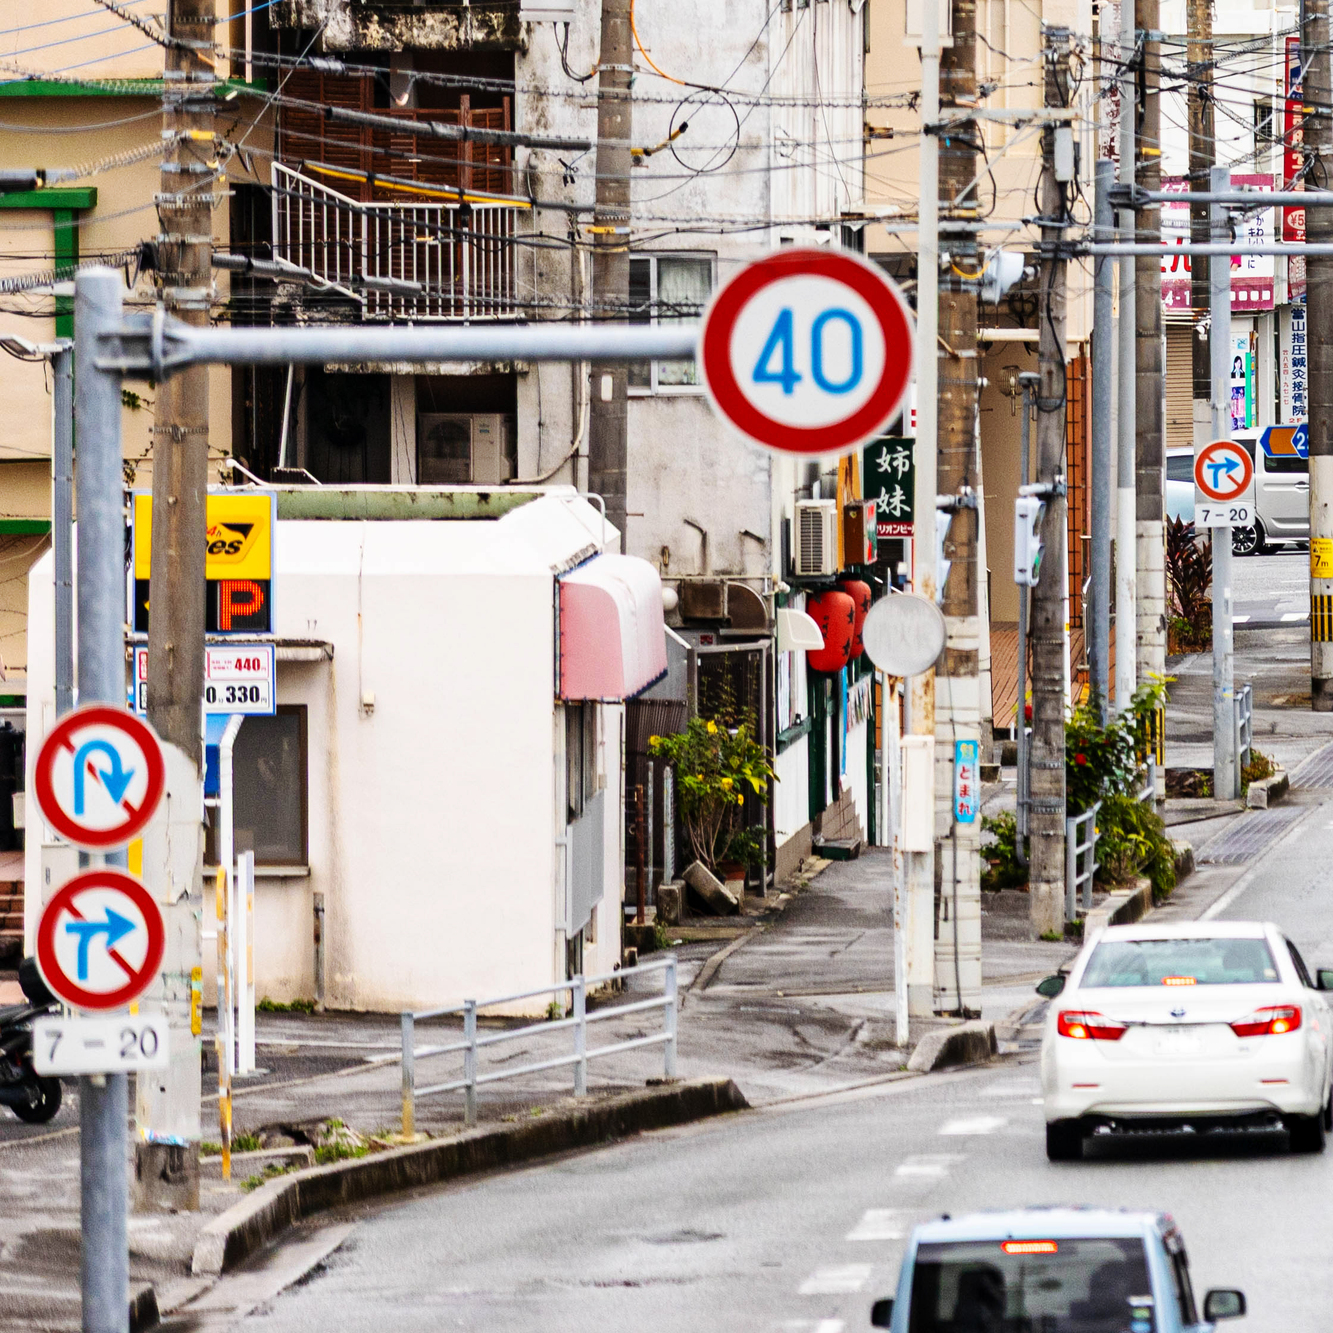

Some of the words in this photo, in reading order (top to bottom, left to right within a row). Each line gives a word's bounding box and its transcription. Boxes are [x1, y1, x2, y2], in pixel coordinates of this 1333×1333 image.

[752, 306, 863, 396] 40
[876, 446, 911, 517] 姉妹
[1202, 510, 1210, 522] 7
[1229, 508, 1248, 521] 20
[220, 580, 264, 631] P
[959, 765, 972, 815] とまれ
[45, 1031, 63, 1062] 7
[119, 1028, 158, 1060] 20
